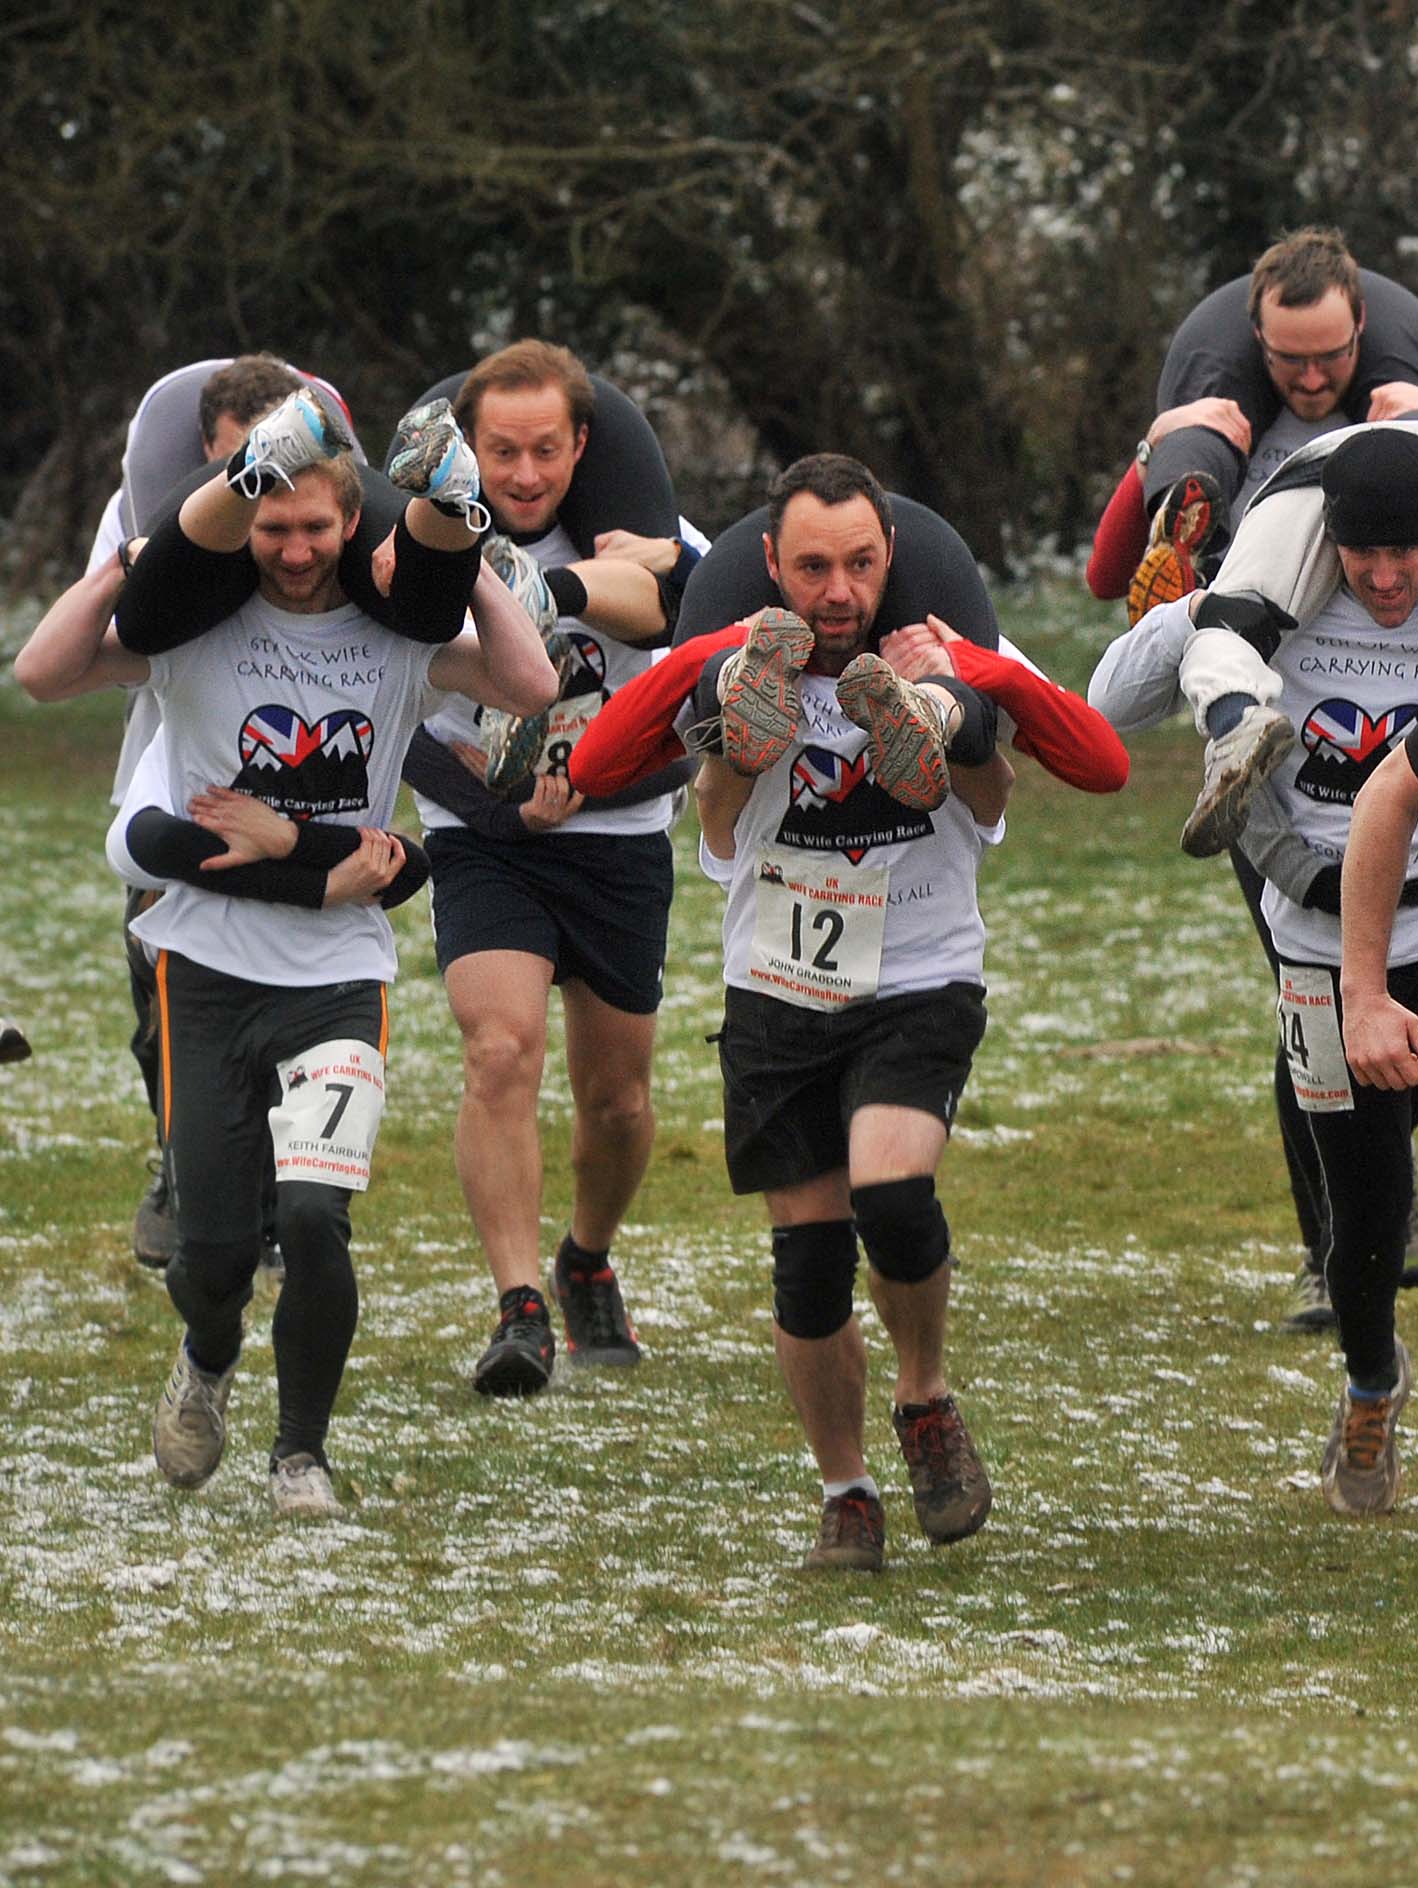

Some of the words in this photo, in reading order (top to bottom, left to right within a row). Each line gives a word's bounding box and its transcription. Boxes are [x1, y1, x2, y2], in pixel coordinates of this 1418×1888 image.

[321, 644, 371, 665] WIFE
[237, 661, 333, 688] CARRYING
[1300, 657, 1405, 680] CARRYING
[1319, 786, 1347, 800] Wife
[284, 798, 335, 813] Carrying
[783, 831, 801, 845] UK
[803, 834, 832, 848] Wife
[835, 829, 893, 848] Carrying
[896, 823, 926, 837] Race
[825, 877, 839, 888] UK
[908, 883, 934, 901] ALL
[809, 888, 855, 905] CARRYING
[858, 894, 884, 907] RACE
[791, 901, 844, 971] 12
[768, 957, 794, 974] JOHN
[796, 967, 852, 988] GRADDON
[1309, 994, 1331, 1007] RACE
[349, 1054, 361, 1065] UK
[332, 1065, 372, 1083] CARRYING
[320, 1082, 355, 1140] 7
